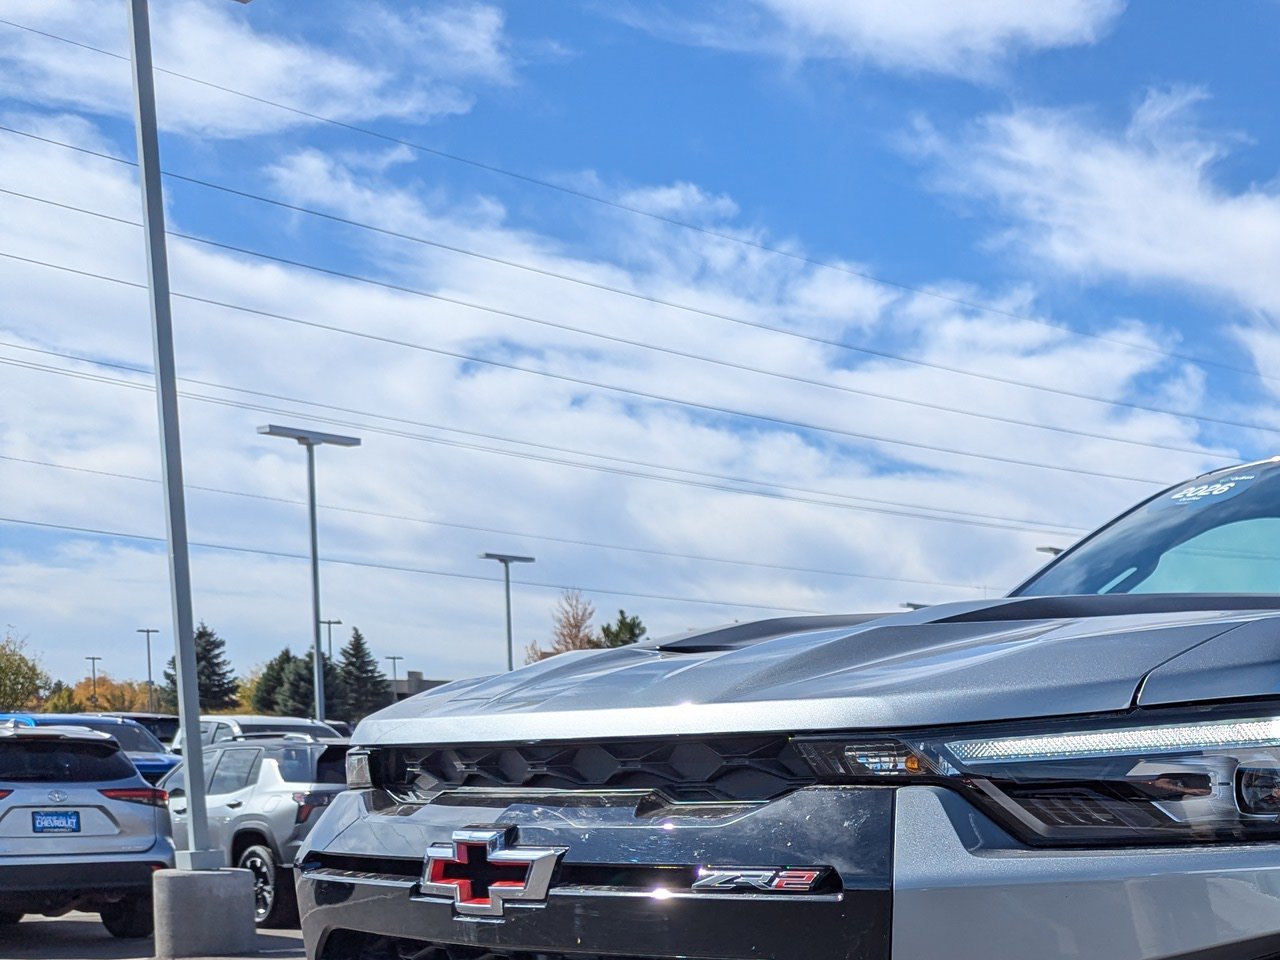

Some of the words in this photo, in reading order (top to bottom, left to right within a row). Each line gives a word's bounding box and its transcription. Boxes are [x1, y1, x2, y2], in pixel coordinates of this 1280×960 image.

[1171, 482, 1236, 499] 2026
[36, 819, 77, 828] CHEVROLET
[691, 870, 820, 891] ZR2
